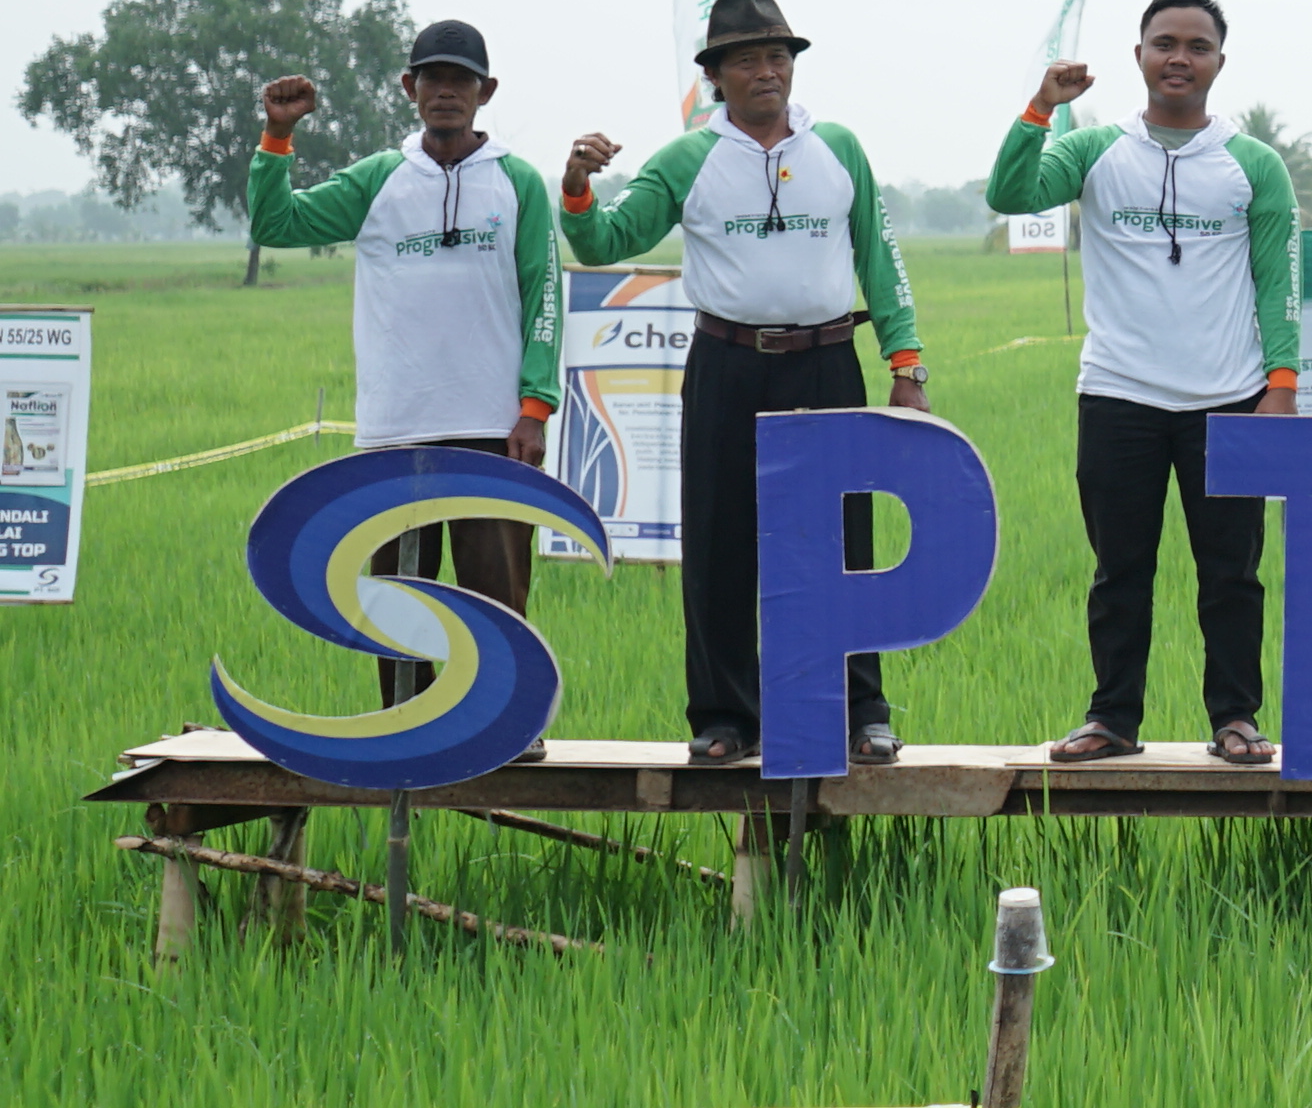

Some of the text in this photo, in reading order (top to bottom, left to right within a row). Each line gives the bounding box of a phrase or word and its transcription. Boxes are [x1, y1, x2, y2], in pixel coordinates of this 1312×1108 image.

[724, 218, 828, 239] Progssive
[1112, 211, 1223, 232] Progressive
[396, 231, 496, 256] Progrsive
[7, 328, 43, 345] 55/25
[47, 329, 72, 346] WG
[625, 323, 694, 349] che
[11, 543, 46, 558] TOP
